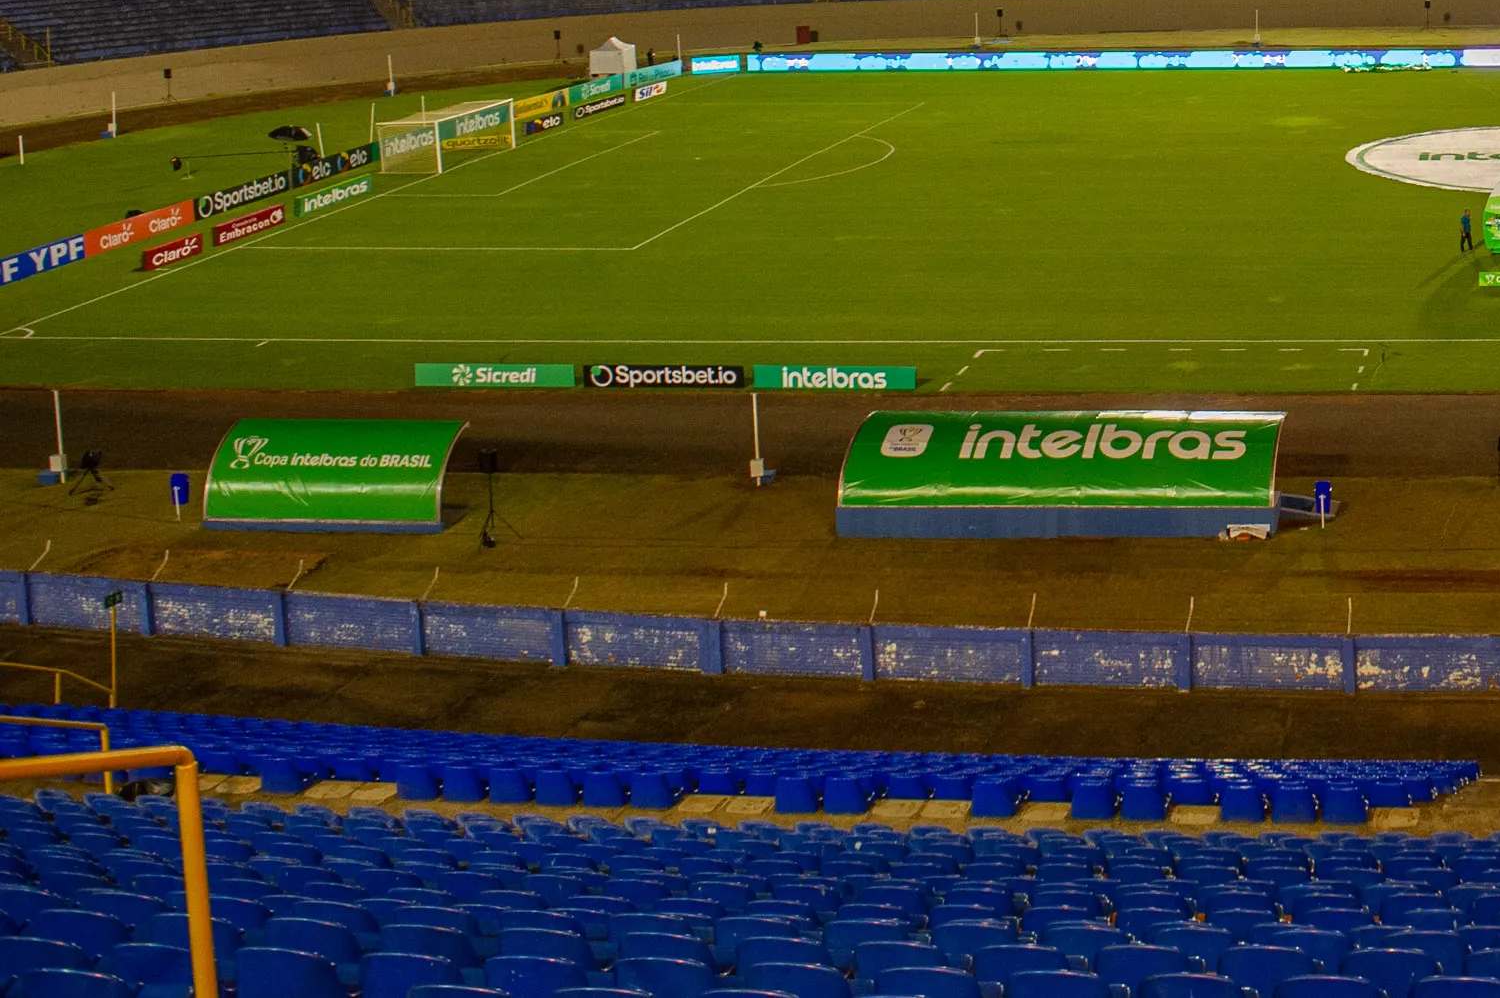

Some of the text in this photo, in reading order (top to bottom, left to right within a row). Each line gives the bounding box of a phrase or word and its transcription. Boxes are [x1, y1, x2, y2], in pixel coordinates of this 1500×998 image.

[639, 85, 653, 99] Sil
[585, 96, 625, 114] Sportsbet.io
[455, 111, 500, 137] intelbras
[384, 129, 434, 158] intelbras
[214, 173, 287, 212] Sportsbet.io
[303, 179, 369, 213] intelbras
[100, 211, 180, 250] Claro Claro
[219, 218, 271, 243] Embracon
[28, 236, 85, 272] YPF
[152, 241, 195, 266] Claro
[475, 367, 537, 384] Sicredi
[615, 365, 737, 388] Sportsbet.io
[781, 366, 888, 389] intelbras
[957, 424, 1248, 460] intelbras
[253, 452, 432, 468] Copa intelbras do BRASIL
